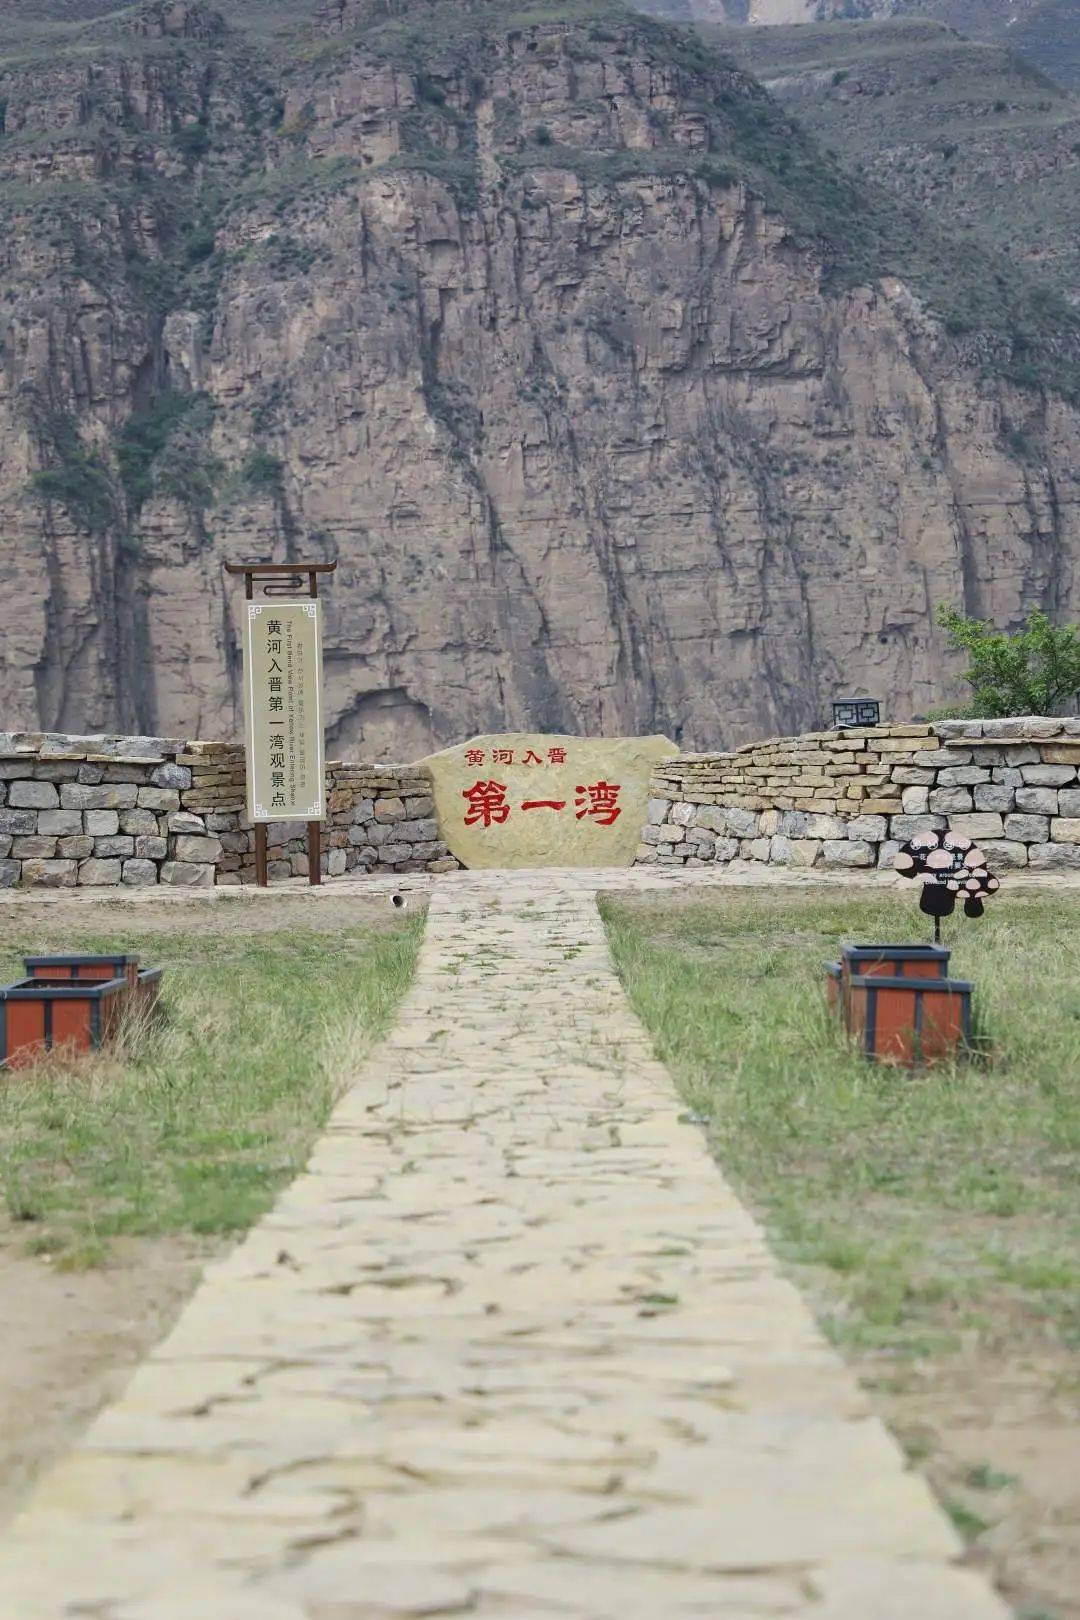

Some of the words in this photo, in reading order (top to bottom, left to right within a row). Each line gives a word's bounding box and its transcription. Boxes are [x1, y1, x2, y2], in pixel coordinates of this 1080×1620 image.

[266, 619, 286, 807] 黄河入晋第一湾观景点
[464, 747, 568, 767] 黄河入晋
[462, 779, 622, 827] 第一湾
